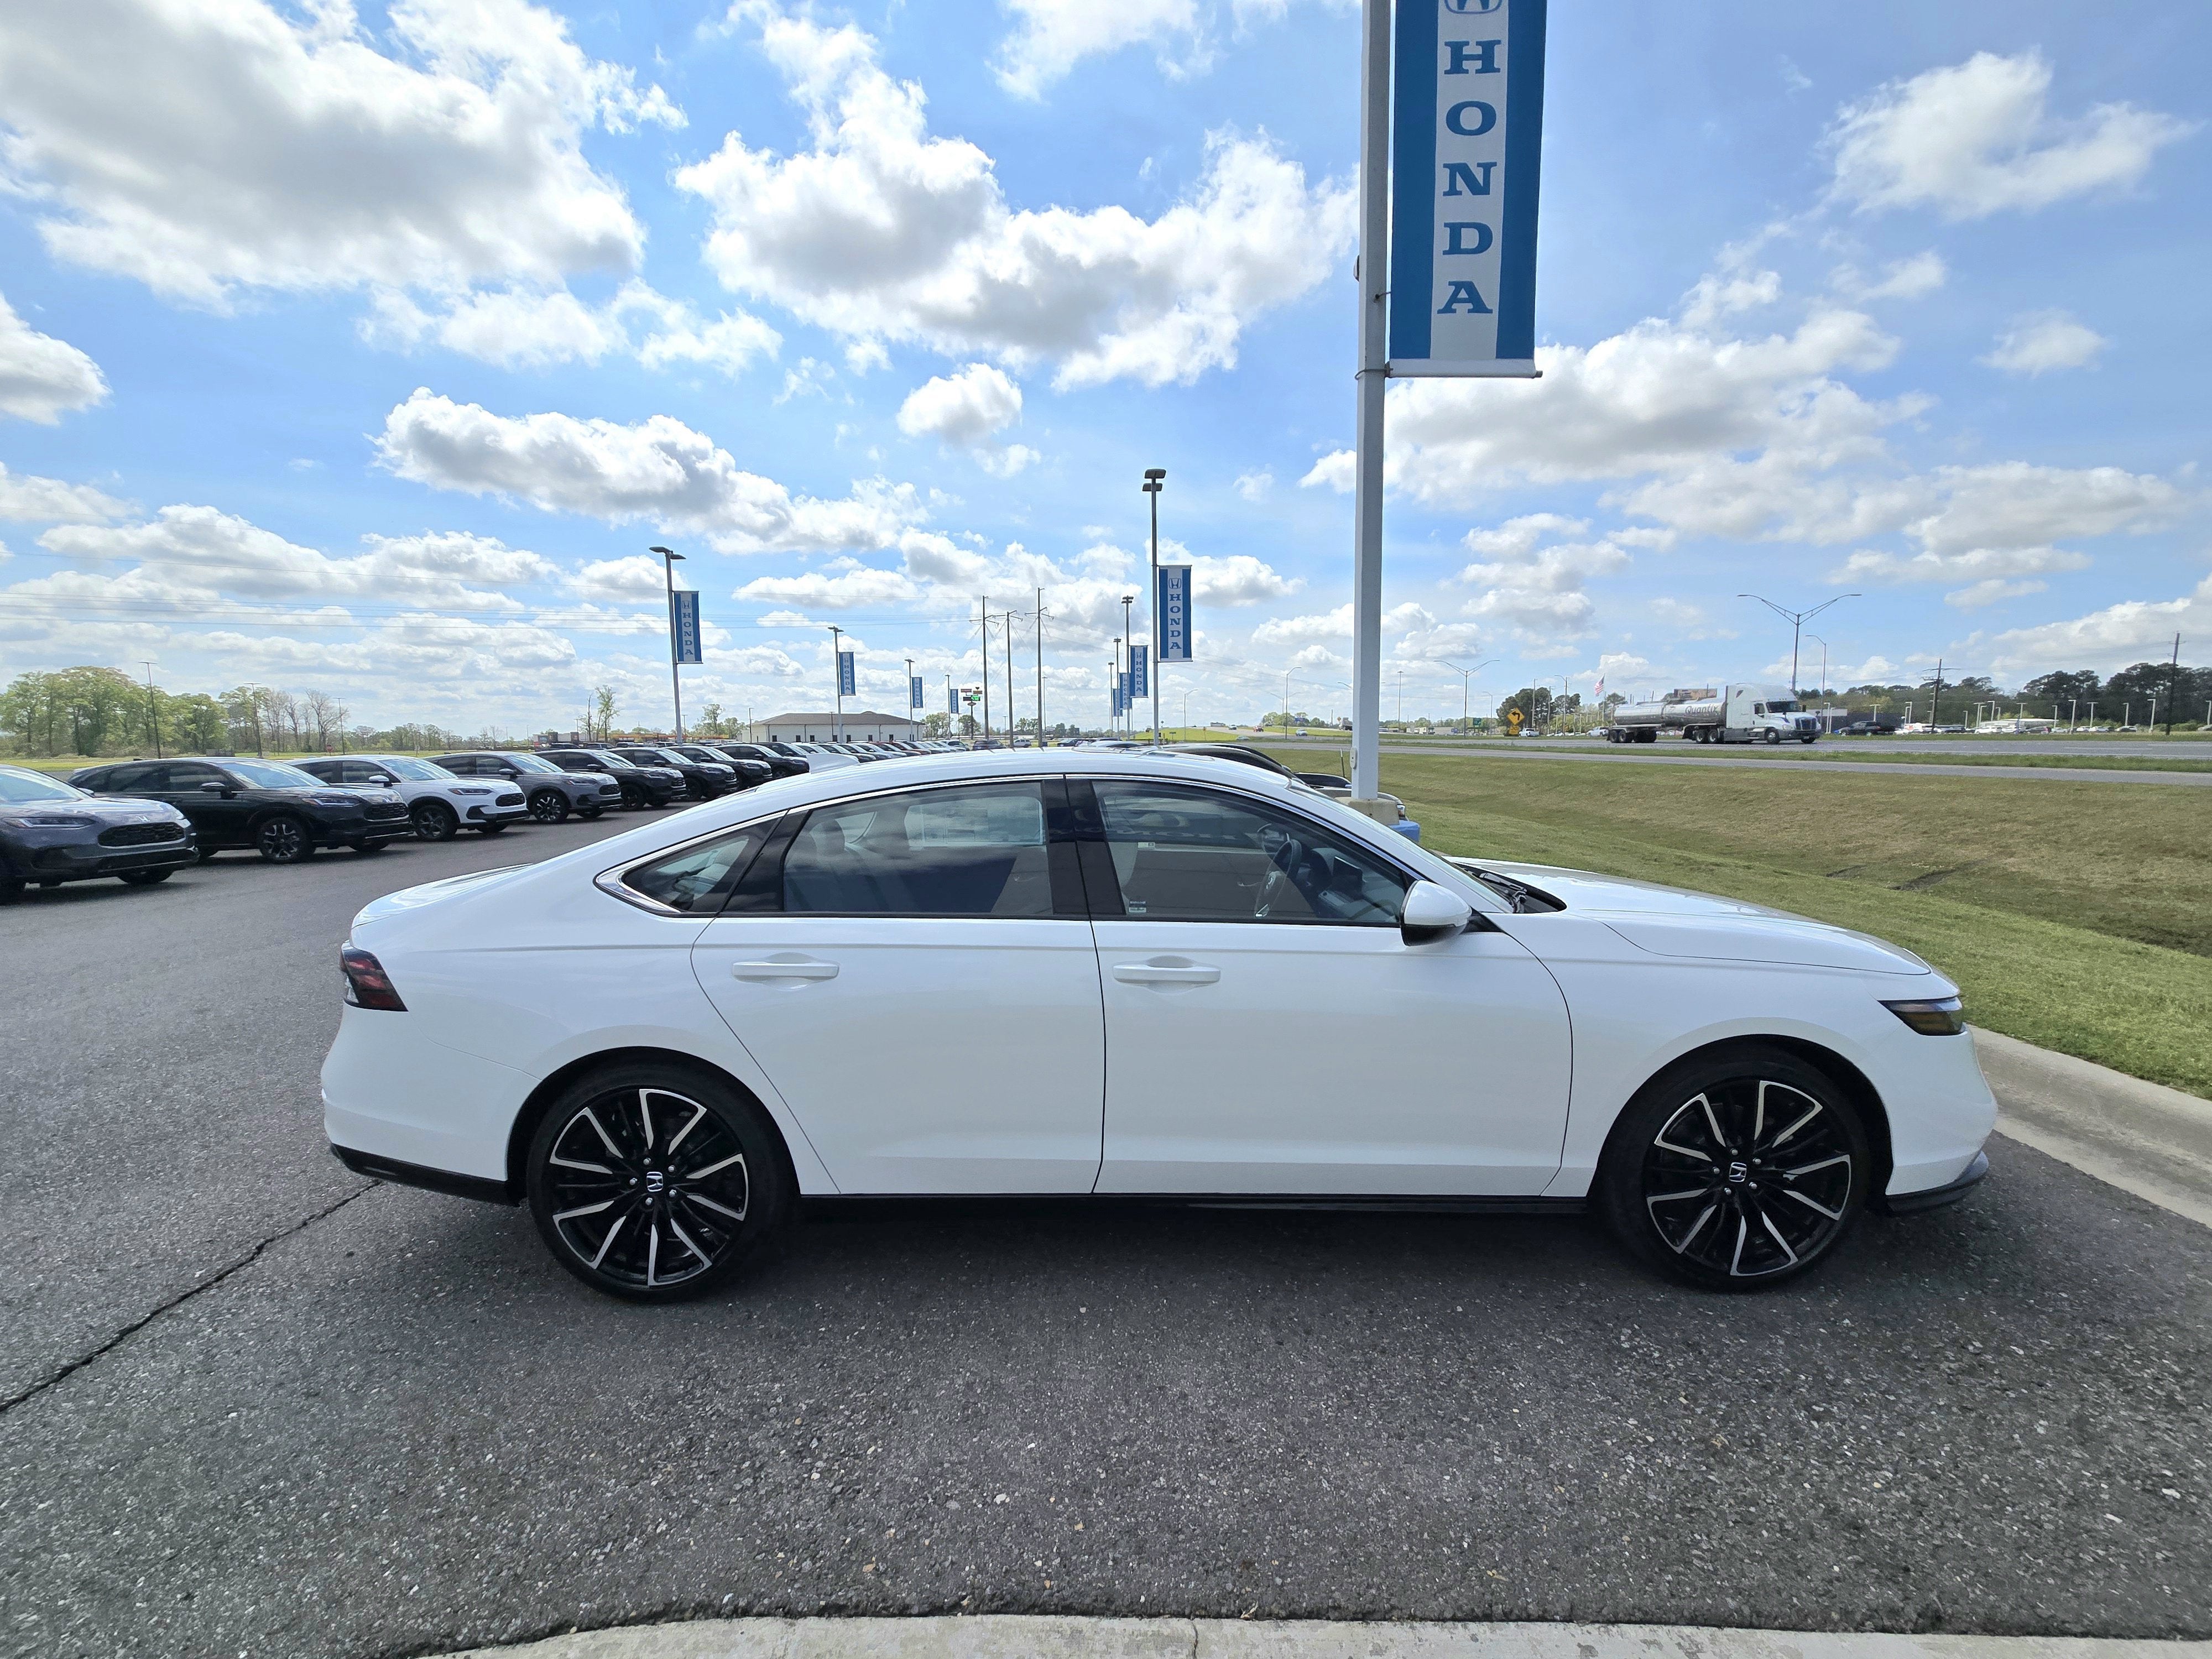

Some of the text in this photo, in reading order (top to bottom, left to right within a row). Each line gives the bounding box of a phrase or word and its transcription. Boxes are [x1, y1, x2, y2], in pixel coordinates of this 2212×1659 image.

[1437, 39, 1501, 314] HONDA
[682, 612, 693, 655] HONDA
[1169, 593, 1182, 649] HONDA
